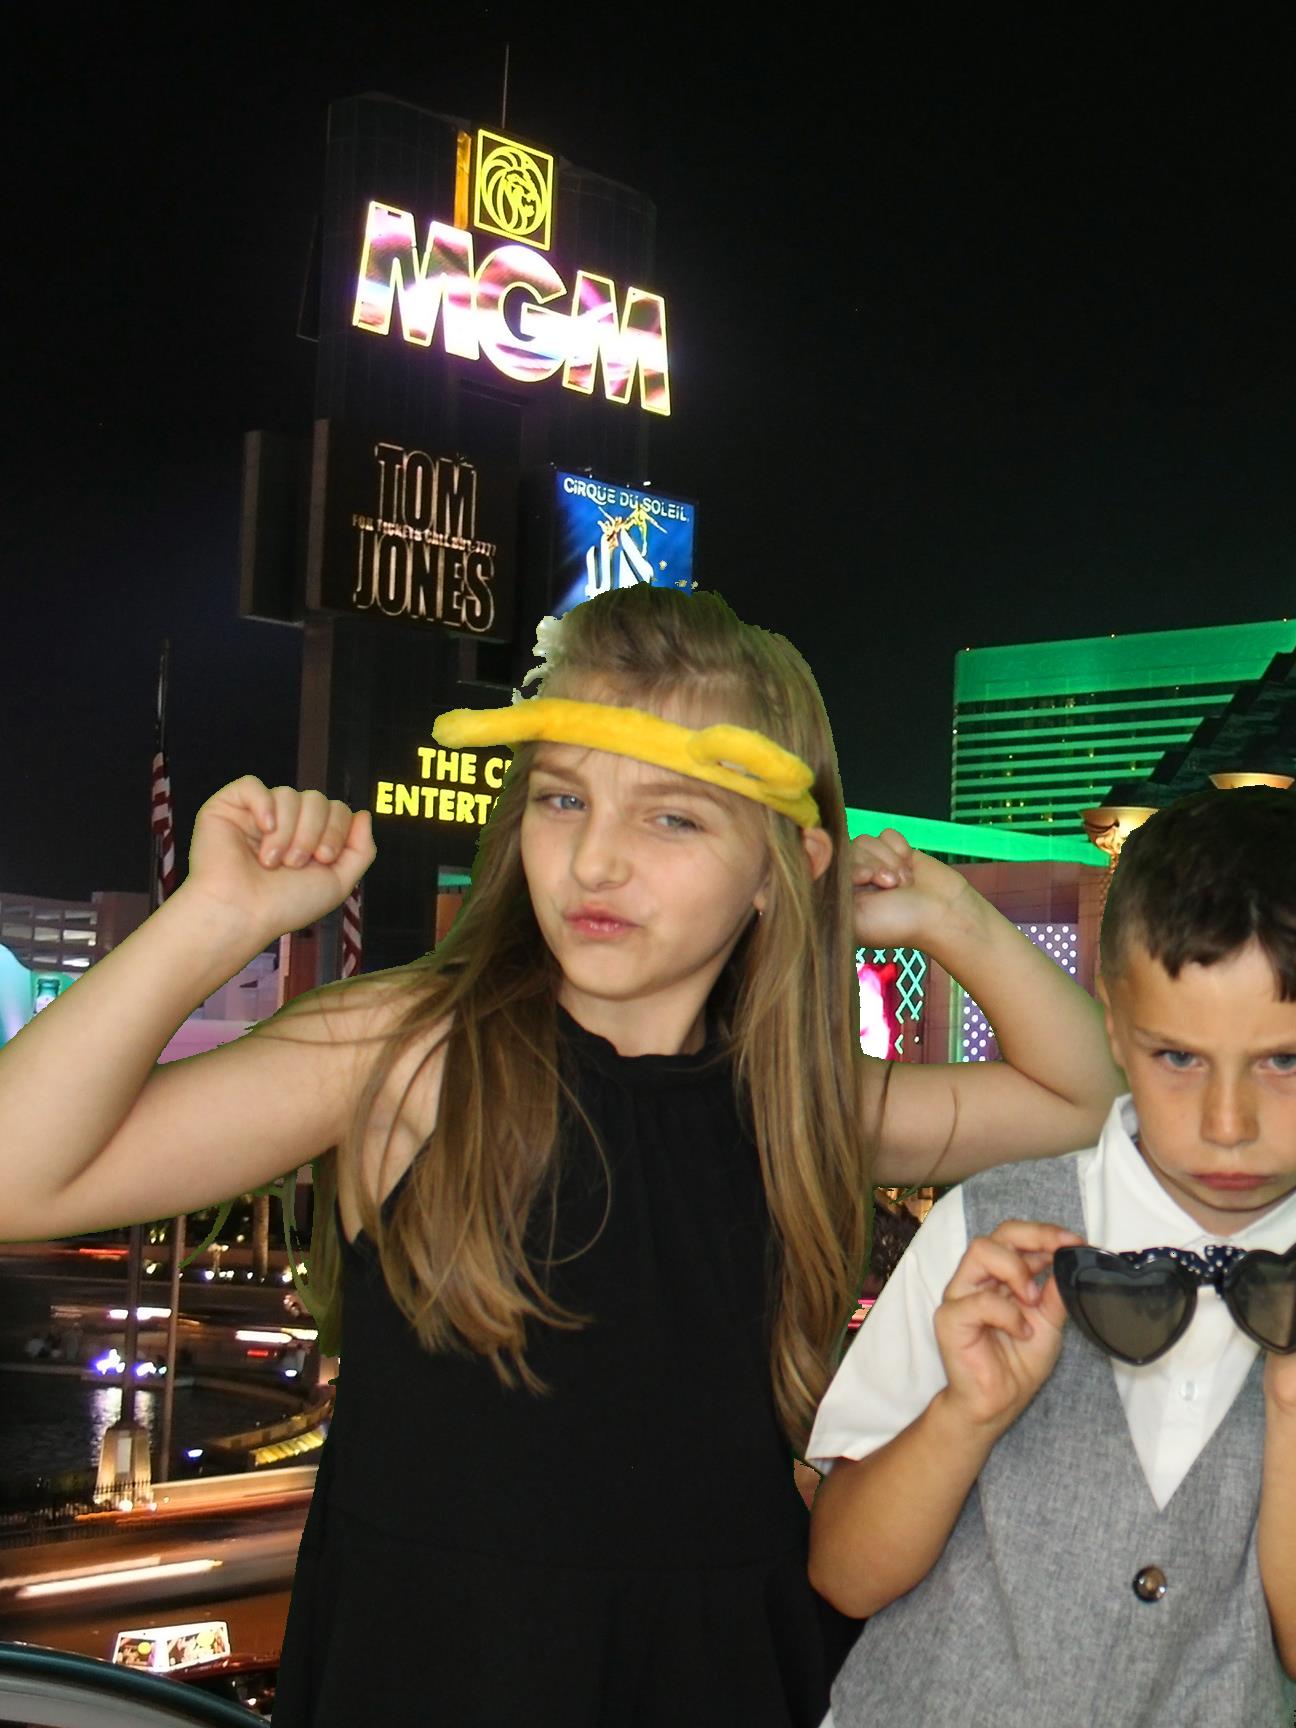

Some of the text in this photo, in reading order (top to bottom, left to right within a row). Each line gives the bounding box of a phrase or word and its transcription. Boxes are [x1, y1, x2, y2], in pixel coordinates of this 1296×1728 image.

[353, 201, 671, 416] MGM
[375, 442, 477, 538] TOM
[563, 477, 688, 522] CIRQUE DU SOLEIL
[352, 513, 374, 531] FOR
[377, 518, 422, 541] TICKETS
[353, 526, 495, 632] JONES
[417, 746, 477, 785] THE
[376, 781, 500, 825] ENTERT
